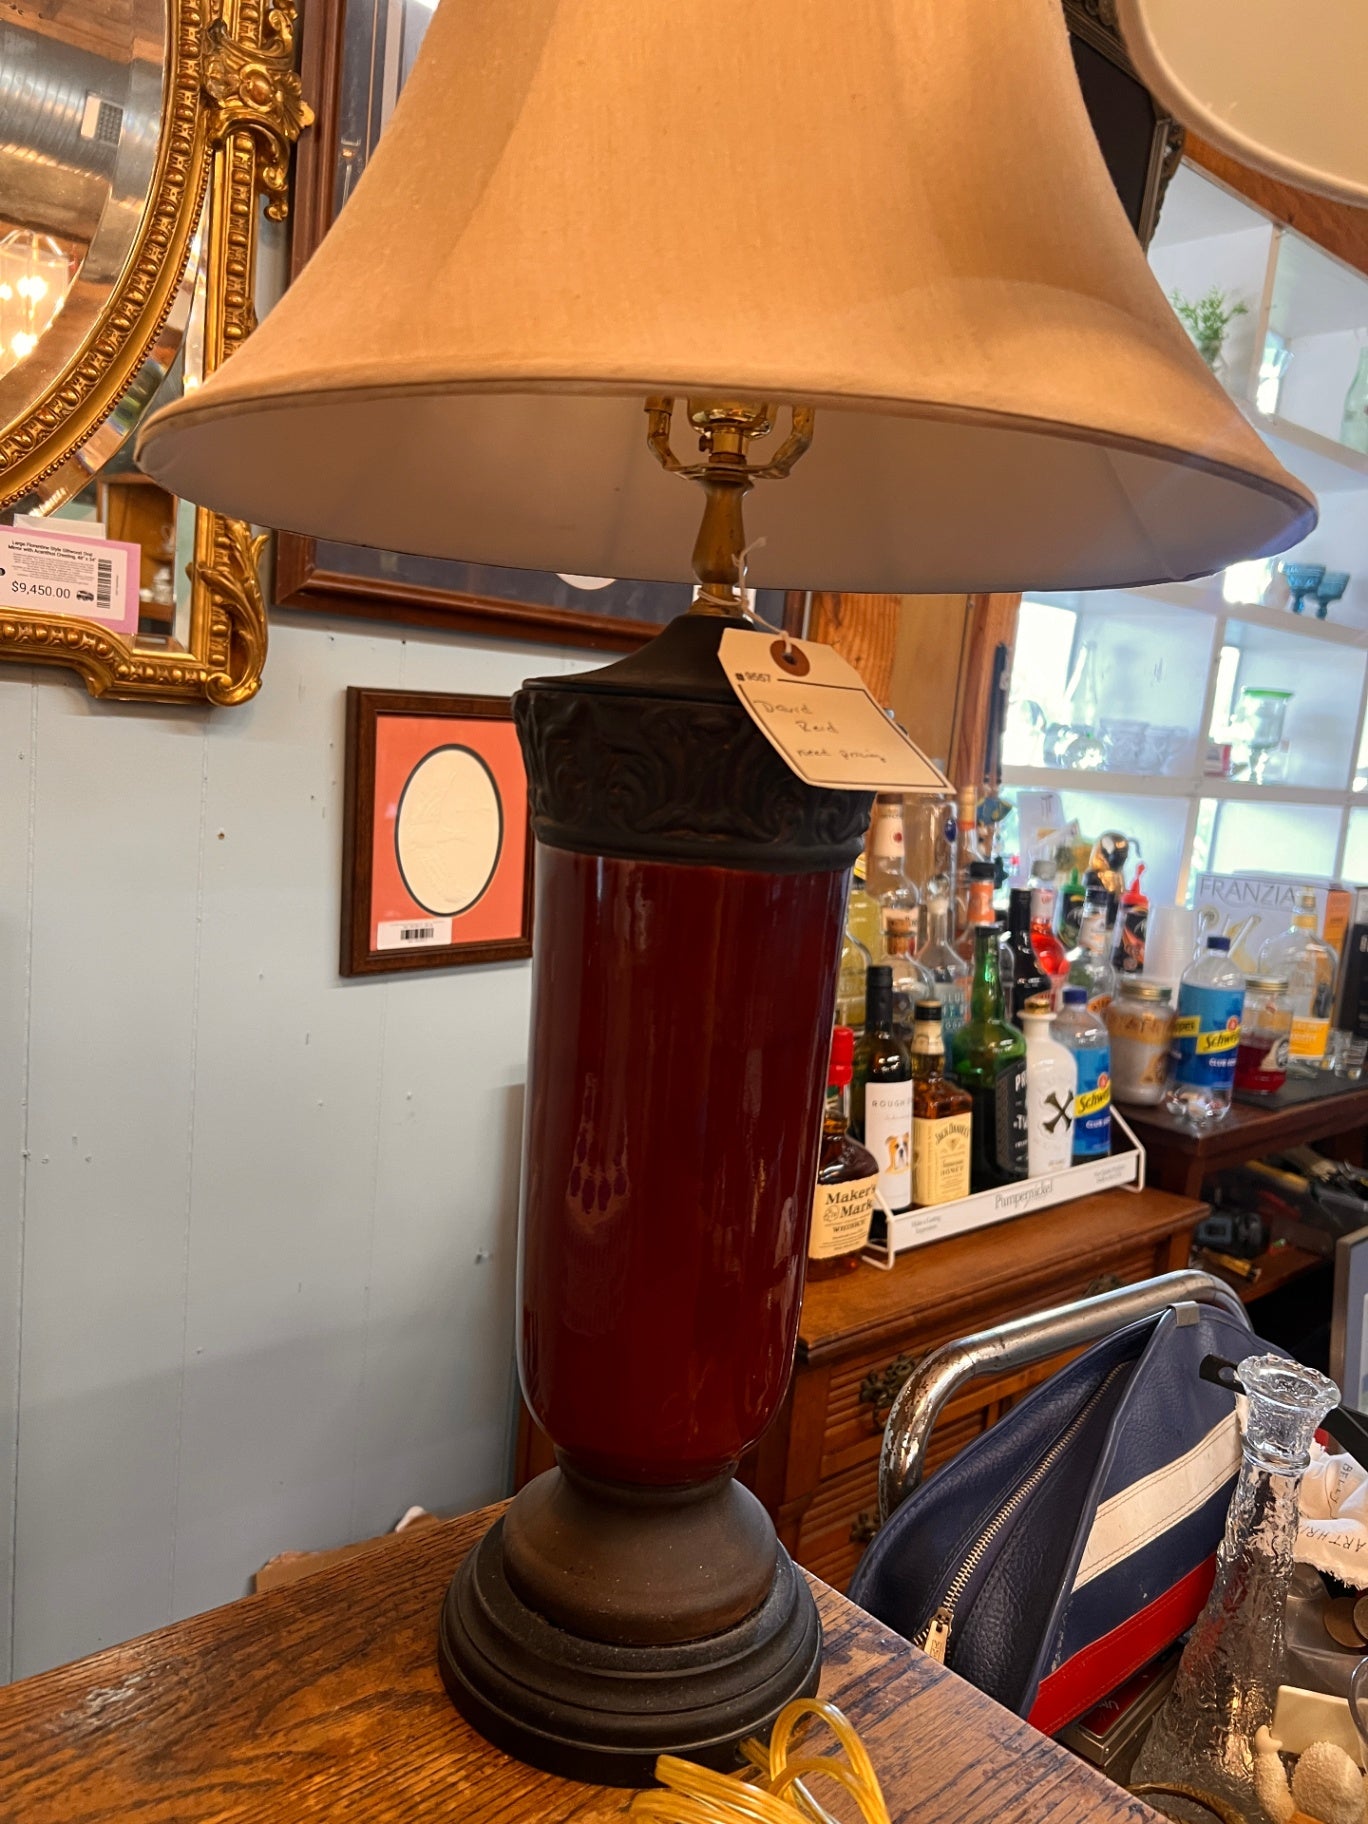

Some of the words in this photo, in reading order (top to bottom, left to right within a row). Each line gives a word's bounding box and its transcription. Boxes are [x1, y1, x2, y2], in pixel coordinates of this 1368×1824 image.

[11, 580, 71, 599] $9,450.00
[1200, 877, 1296, 905] FRANZIA
[935, 1126, 949, 1145] JACK
[825, 1184, 876, 1205] Maker's
[995, 1178, 1054, 1210] Pumpernickel
[840, 1199, 873, 1218] Mark
